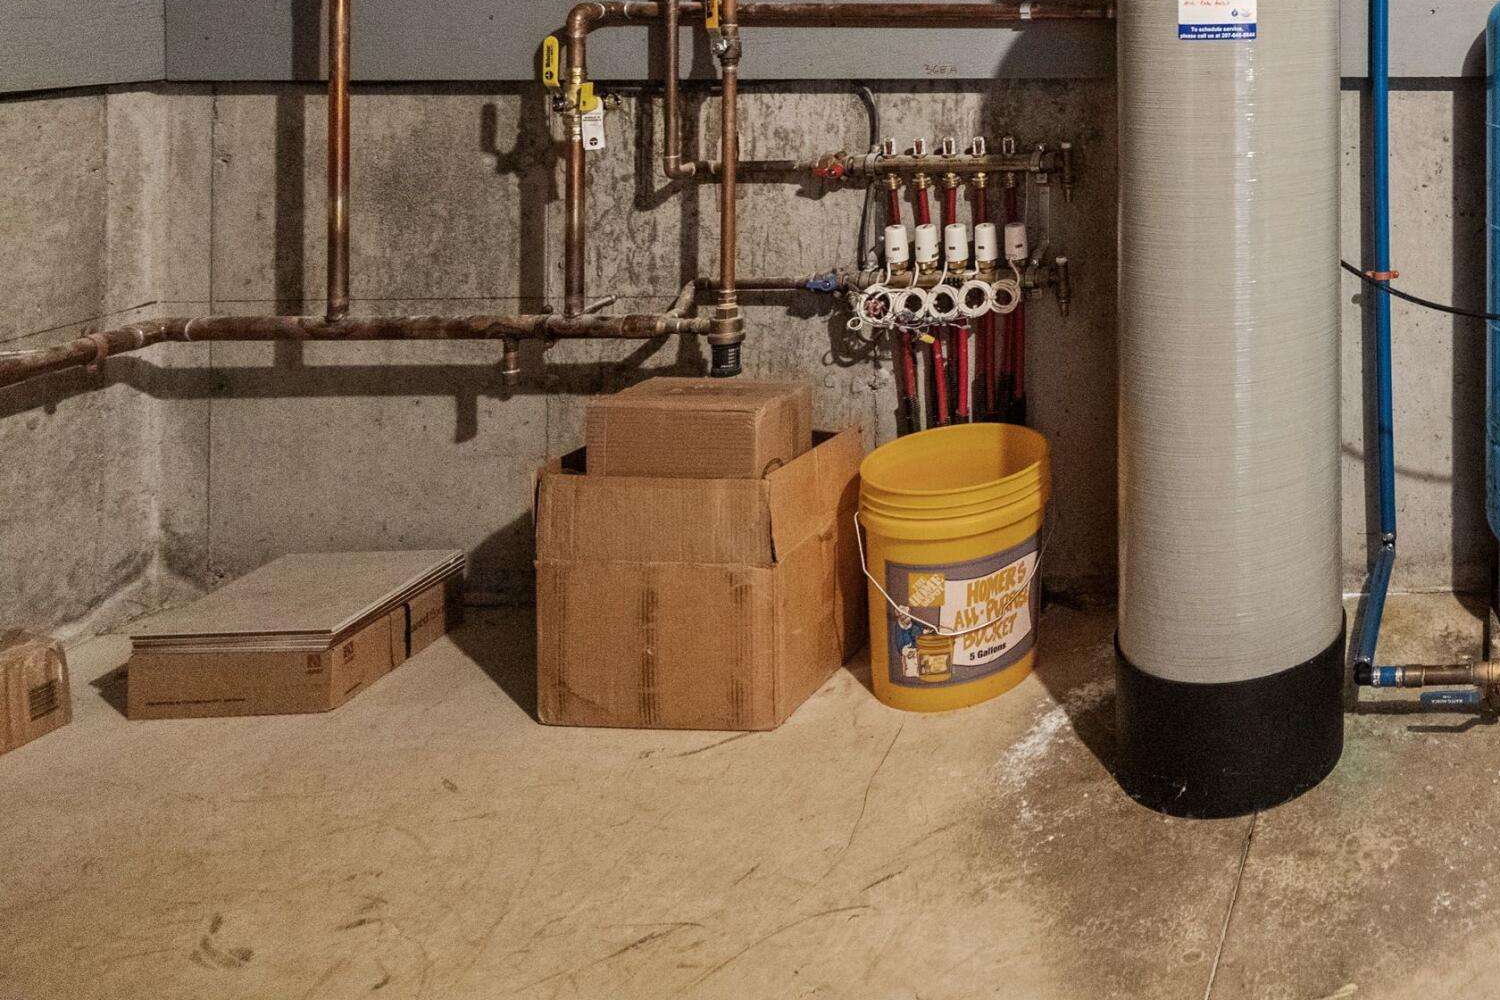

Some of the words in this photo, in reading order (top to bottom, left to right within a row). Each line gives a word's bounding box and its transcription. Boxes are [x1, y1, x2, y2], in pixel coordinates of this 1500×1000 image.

[966, 560, 1027, 607] HOMER'S
[963, 612, 1018, 651] BUCKET
[969, 652, 975, 661] 5
[977, 642, 1007, 659] Gallons
